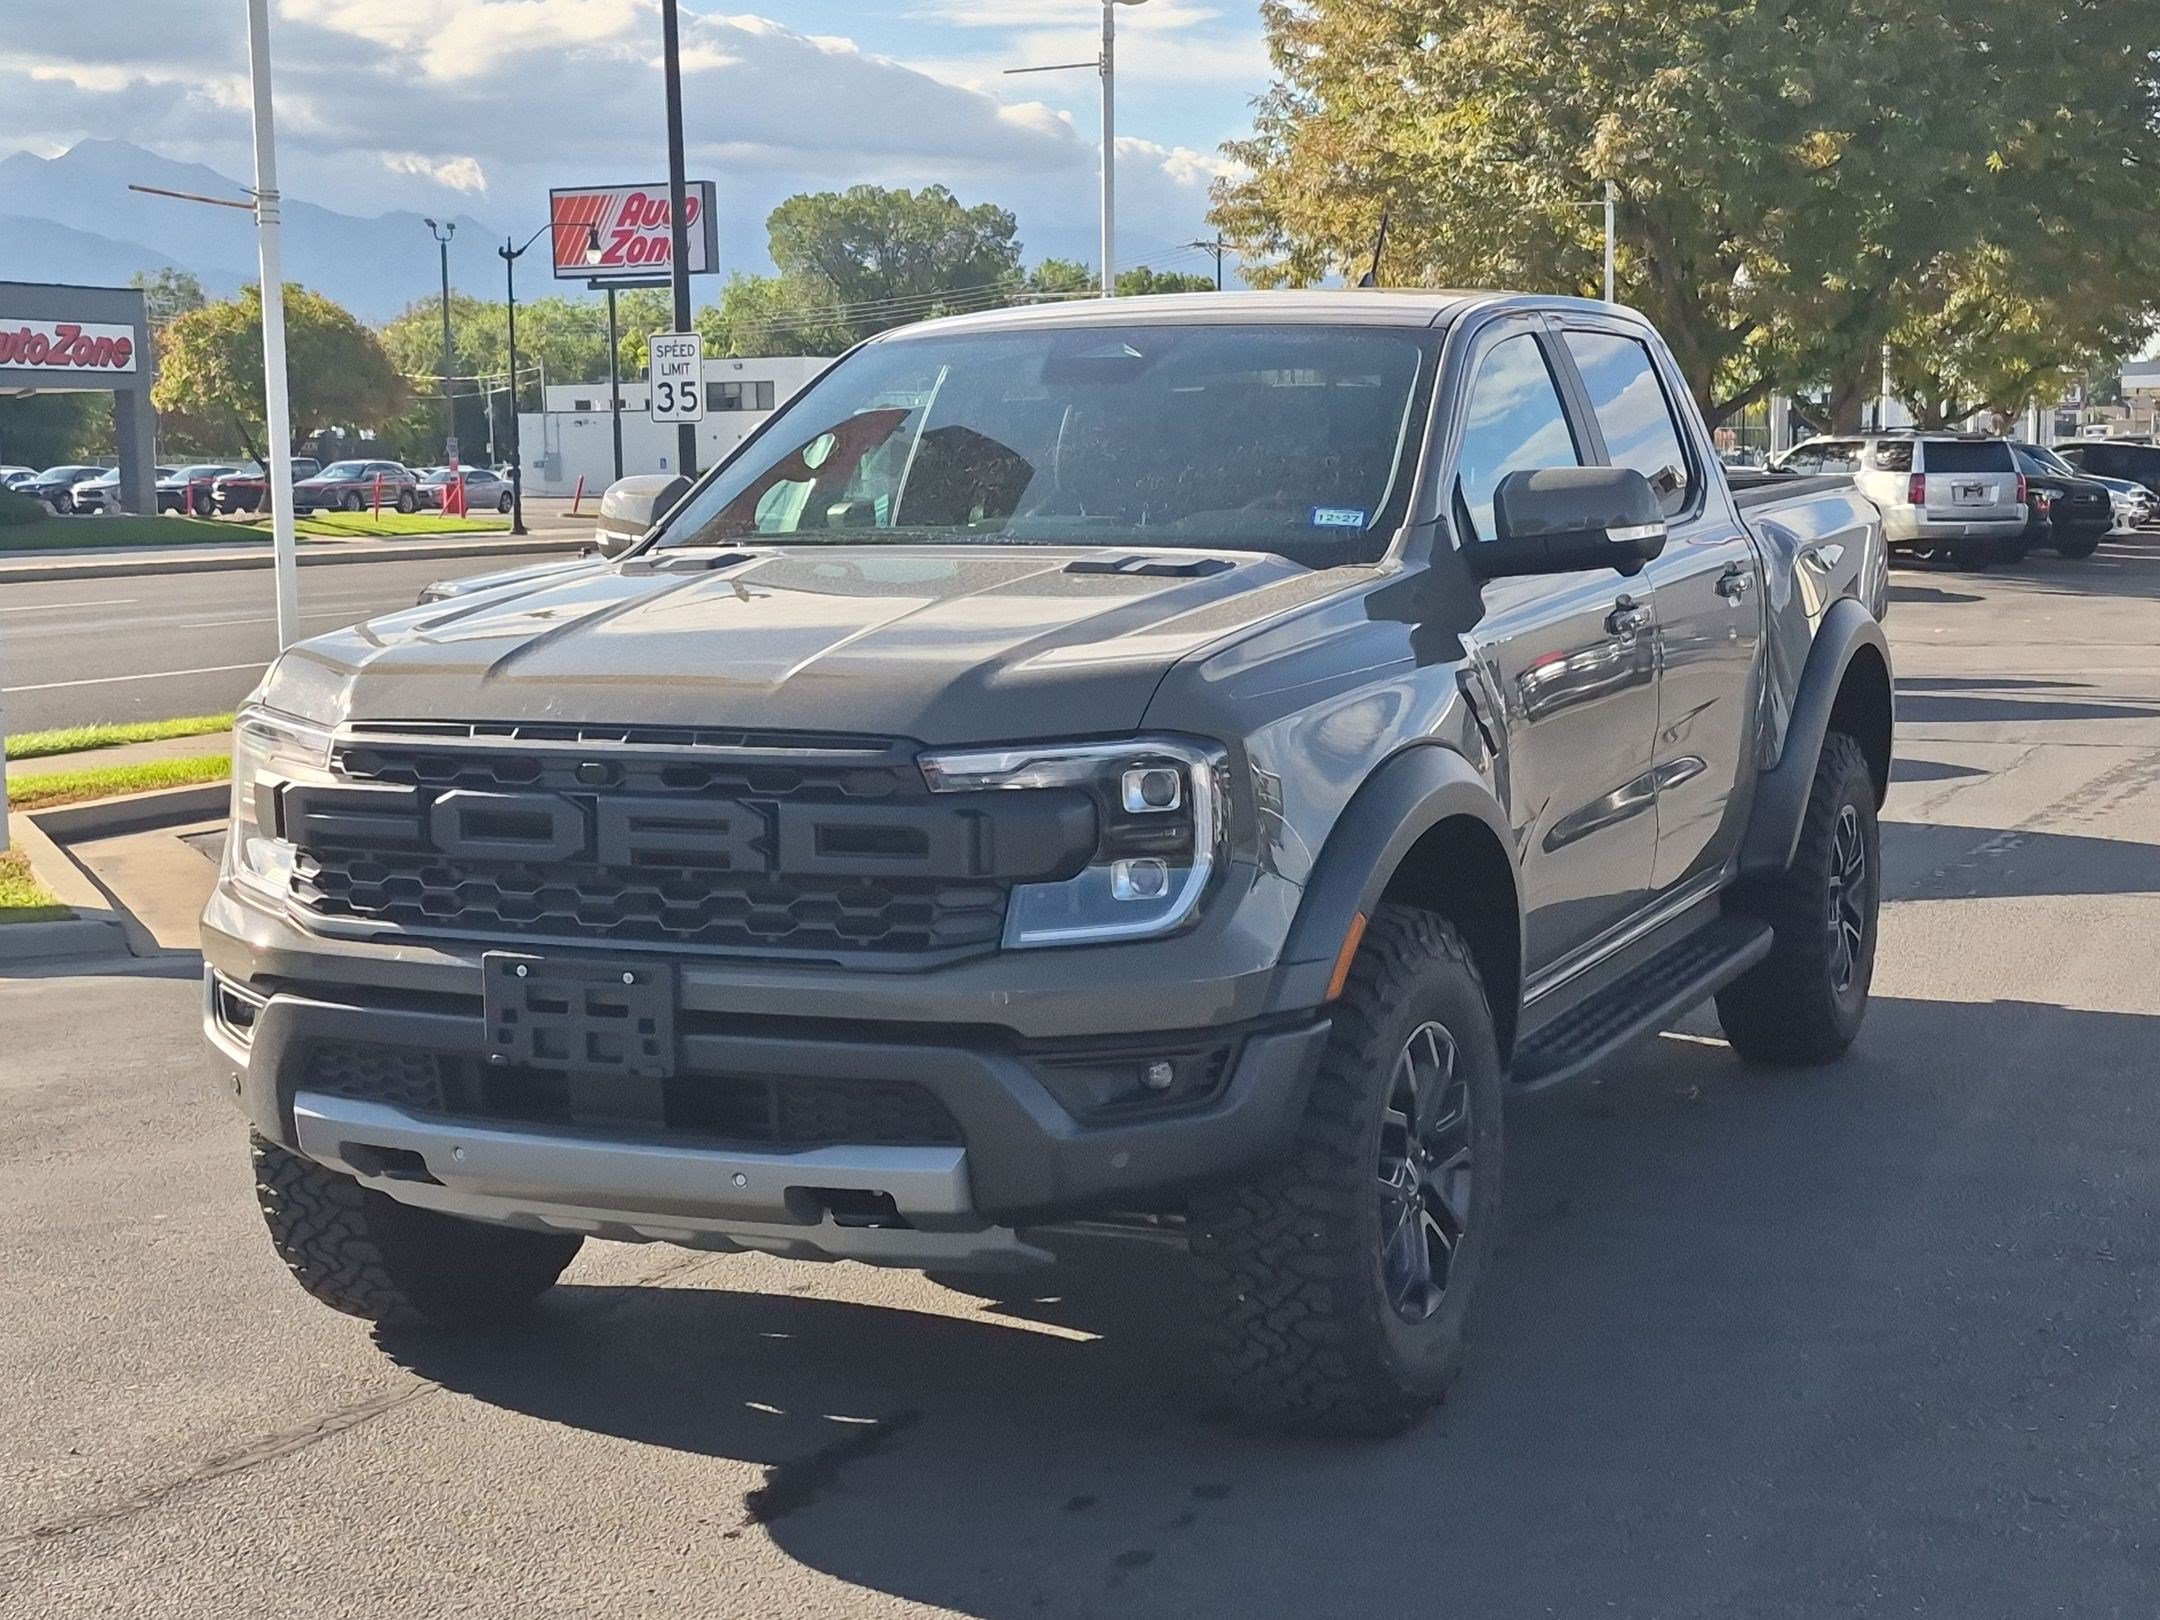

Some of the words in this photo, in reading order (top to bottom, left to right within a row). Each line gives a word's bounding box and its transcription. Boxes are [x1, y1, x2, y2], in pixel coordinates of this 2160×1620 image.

[615, 191, 700, 228] Auo
[601, 229, 672, 265] Zon
[0, 325, 133, 368] utoZone
[656, 344, 696, 358] SPEED
[661, 362, 690, 376] LIMIT
[657, 381, 698, 412] 35
[283, 784, 975, 877] FORD
